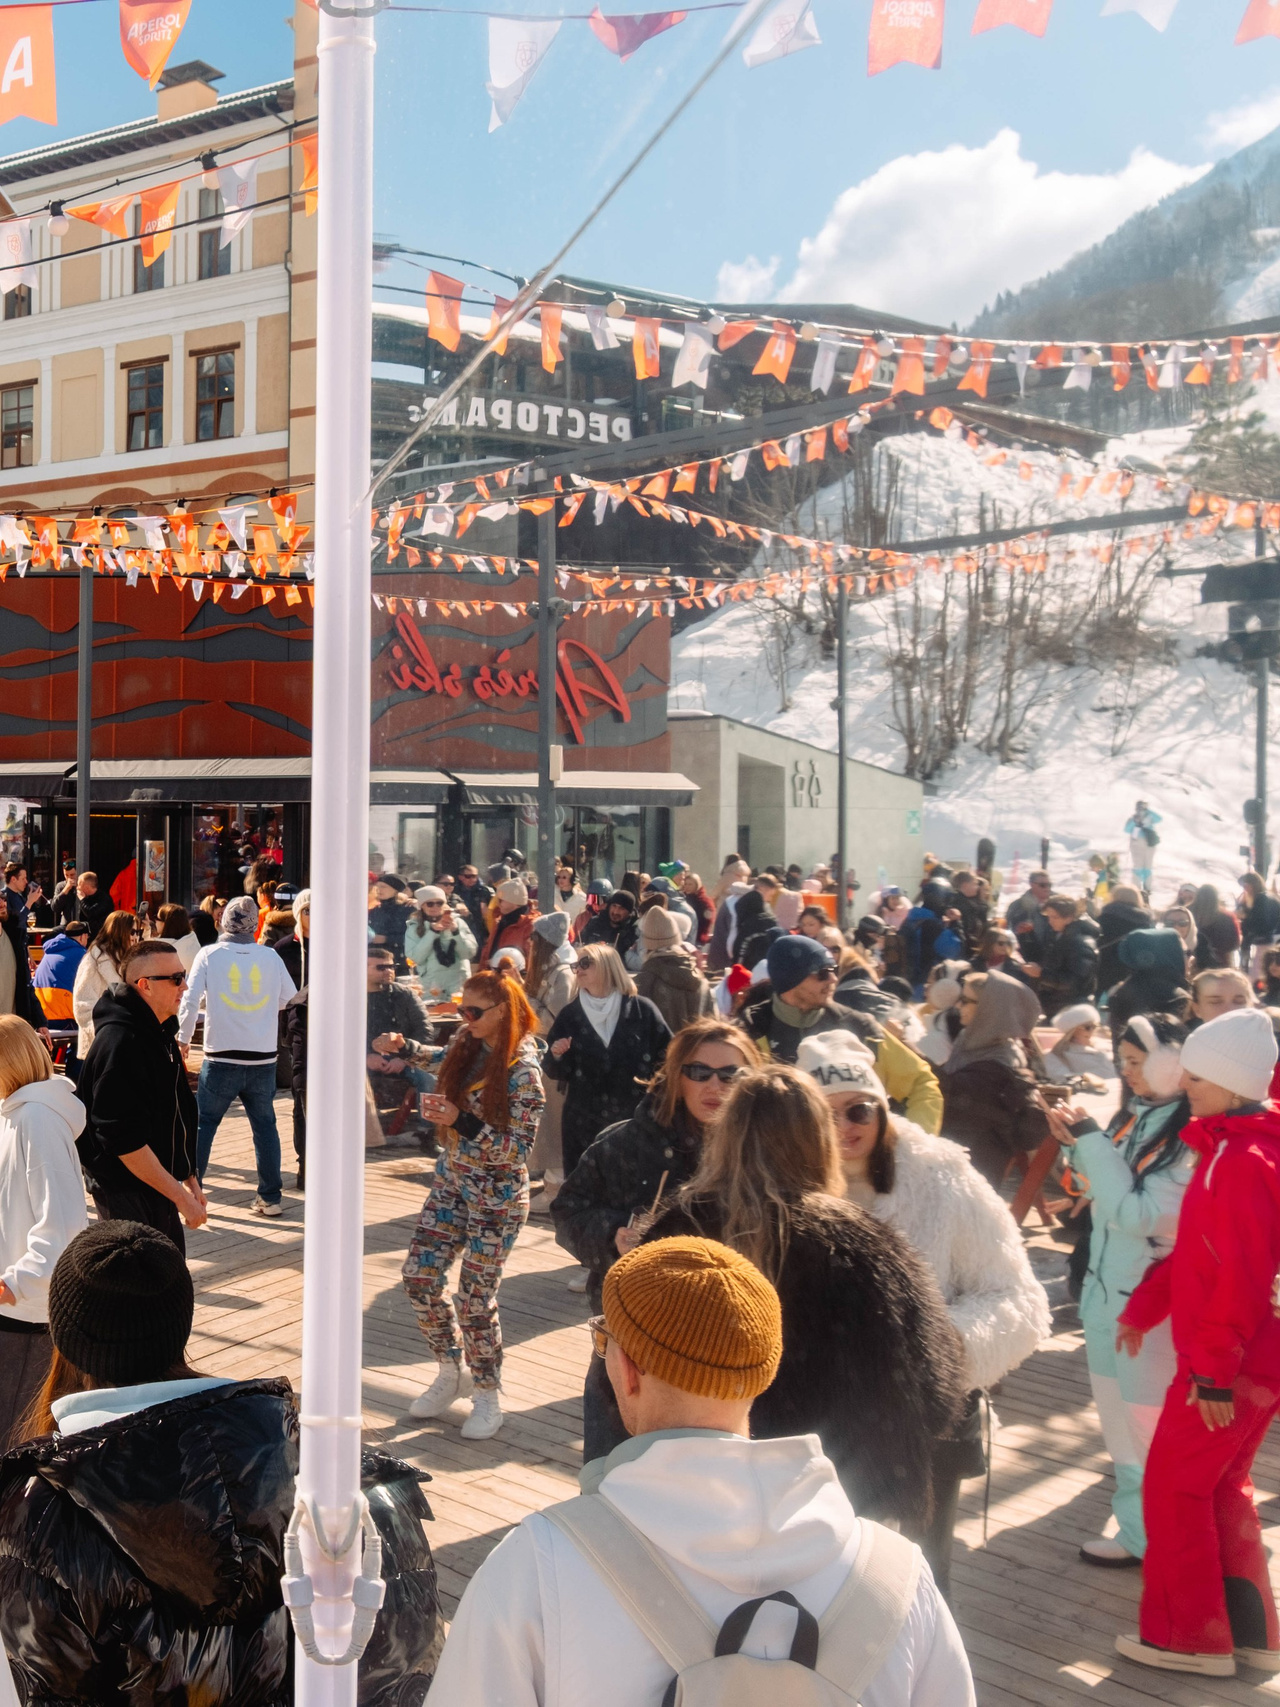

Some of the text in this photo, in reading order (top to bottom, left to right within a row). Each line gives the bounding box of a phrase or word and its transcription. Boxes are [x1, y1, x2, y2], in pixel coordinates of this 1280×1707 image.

[127, 13, 181, 41] APEROL
[138, 29, 173, 46] SPRITZ
[1, 36, 33, 94] A
